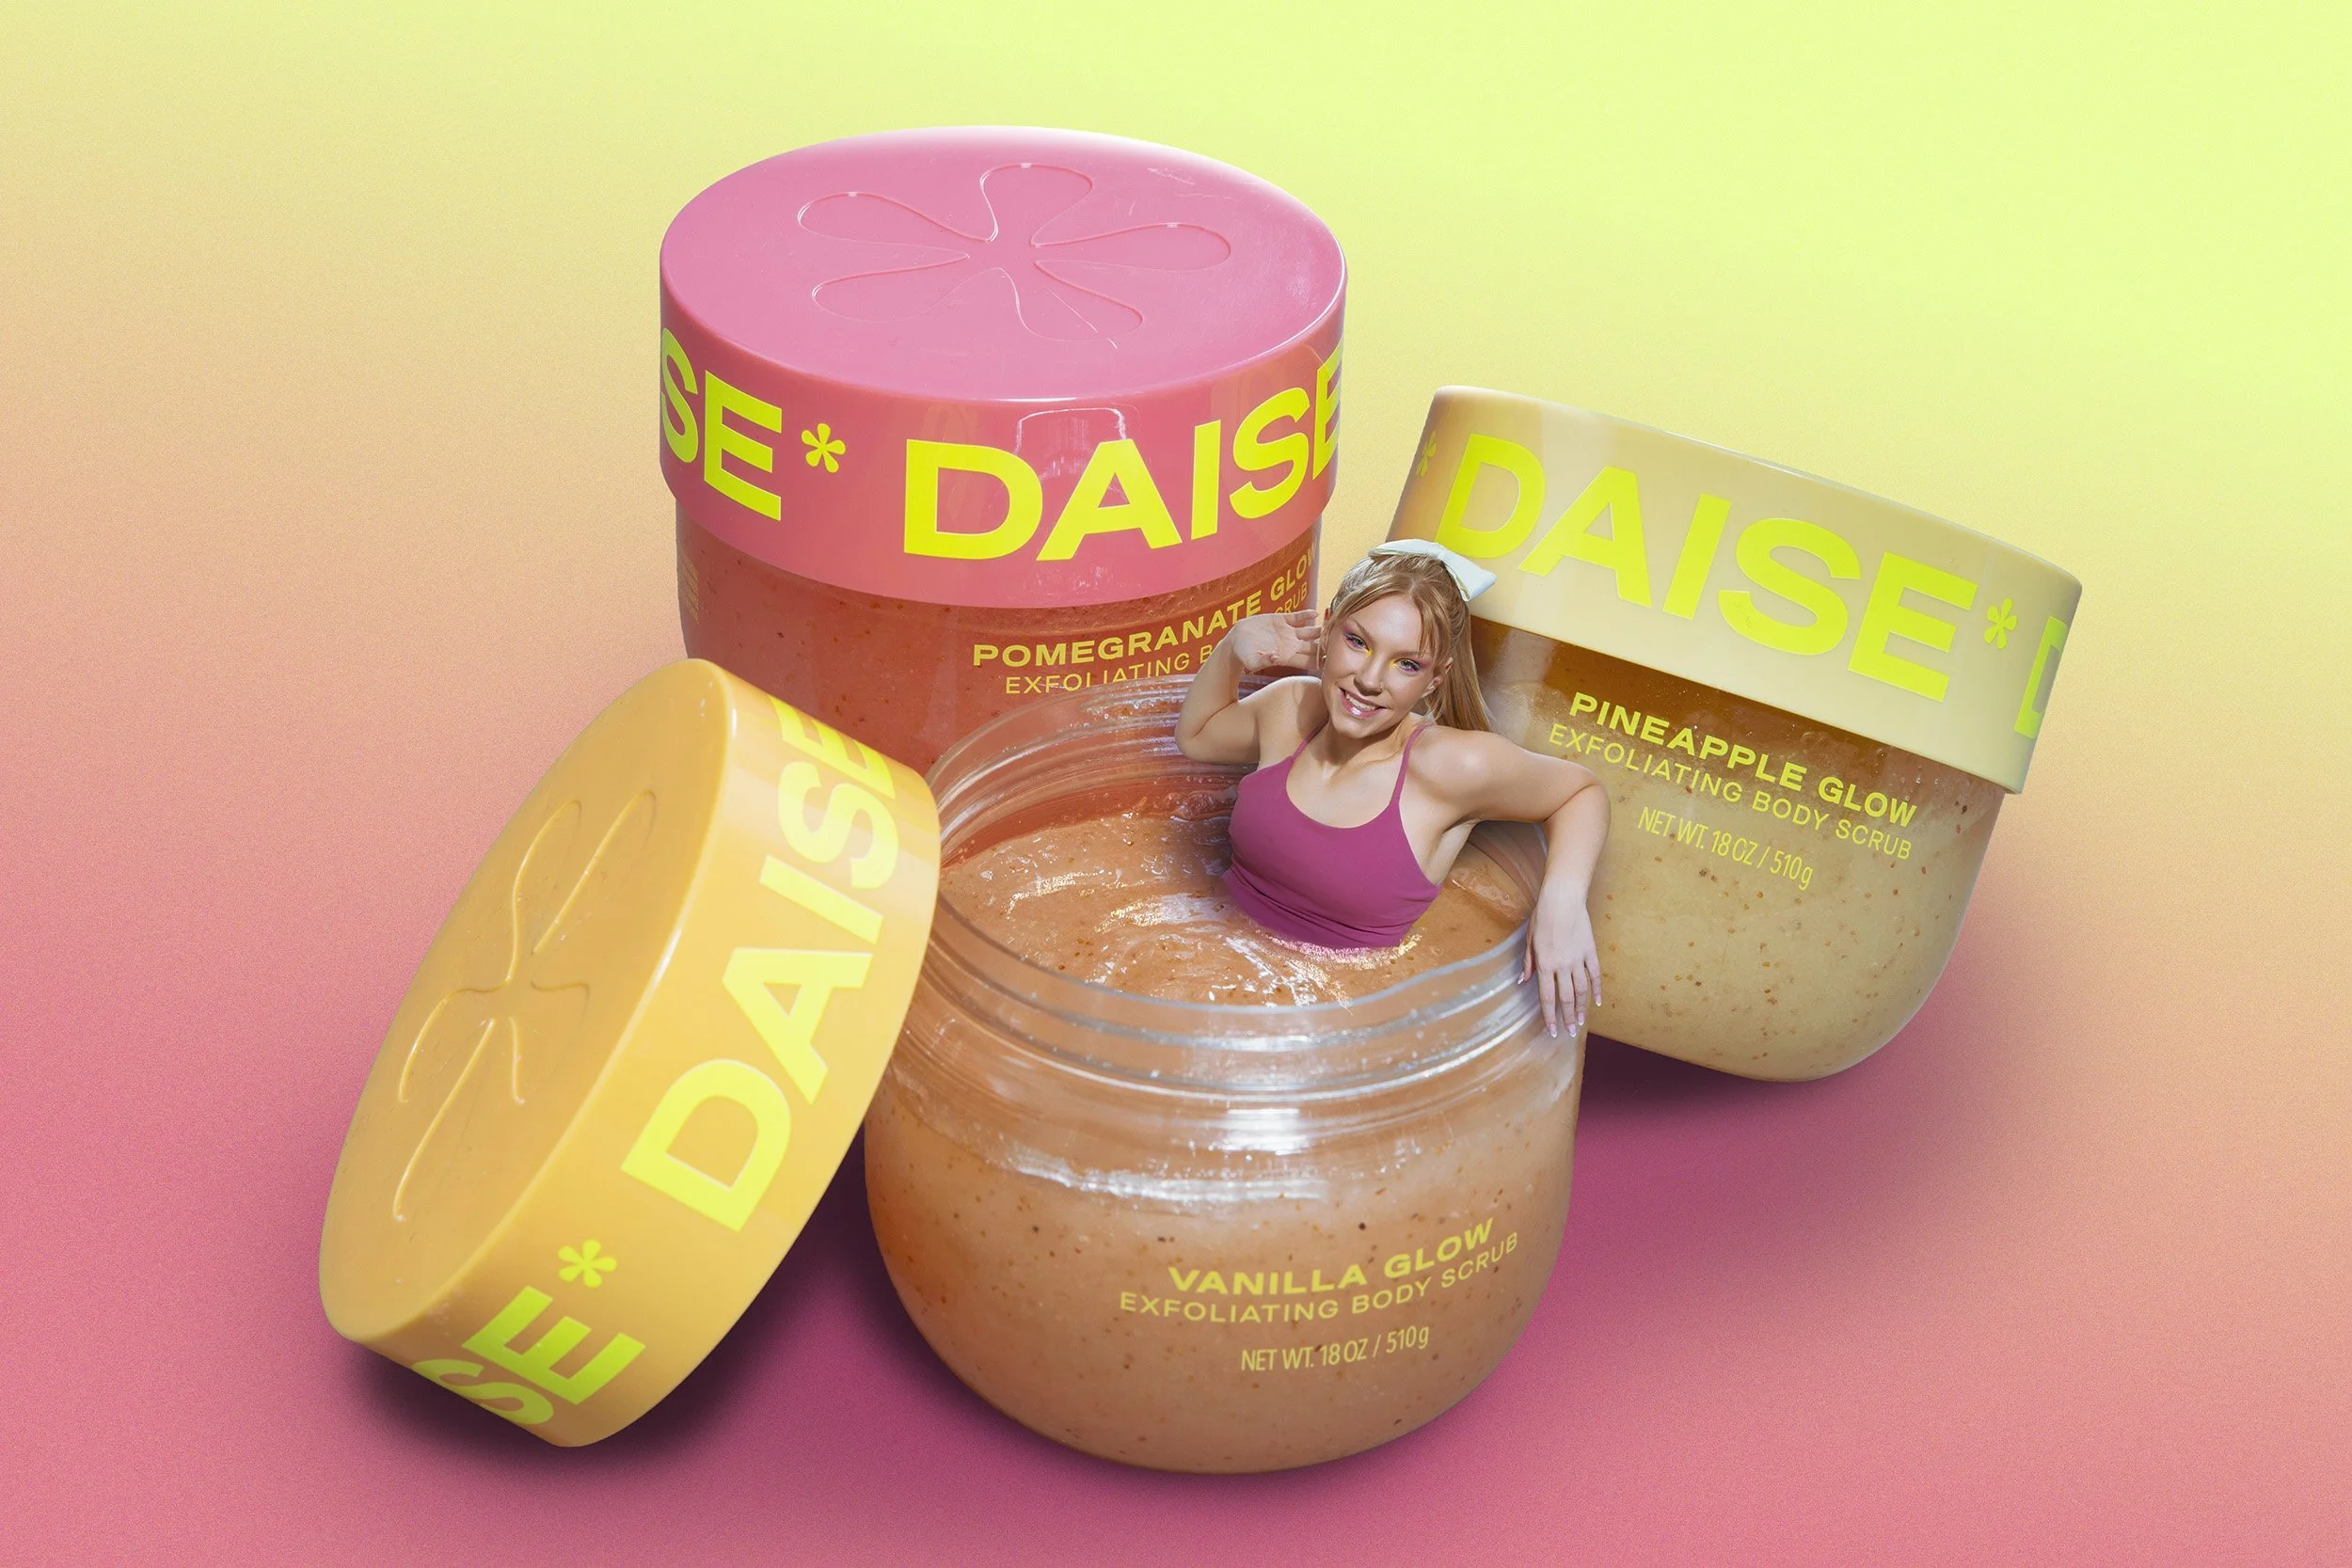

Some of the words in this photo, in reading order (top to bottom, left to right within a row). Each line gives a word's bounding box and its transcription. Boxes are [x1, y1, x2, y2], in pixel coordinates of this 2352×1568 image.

[903, 338, 1343, 561] DAISE
[1434, 433, 1979, 703] DAISE
[973, 590, 1262, 667] POMEGRANATE
[1549, 723, 1742, 802] EXFOLIATING
[1752, 791, 1830, 831] BODY
[1836, 819, 1913, 860] SCRUB
[1569, 691, 1807, 791] PINEAPPLE
[1818, 776, 1917, 828] GLOW
[1638, 806, 1676, 835] NET
[1677, 821, 1706, 850] WT.
[1771, 849, 1814, 892] 510g
[620, 694, 899, 1233] DAISE
[1120, 1291, 1339, 1323] EXFOLIATING
[1352, 1277, 1432, 1314] BODY
[1441, 1232, 1518, 1288] SCRUB
[1168, 1264, 1367, 1295] VANILLA
[1384, 1217, 1494, 1278] GLOW
[1241, 1348, 1277, 1370] NET
[1282, 1346, 1314, 1370] WT.
[1386, 1325, 1430, 1354] 510g
